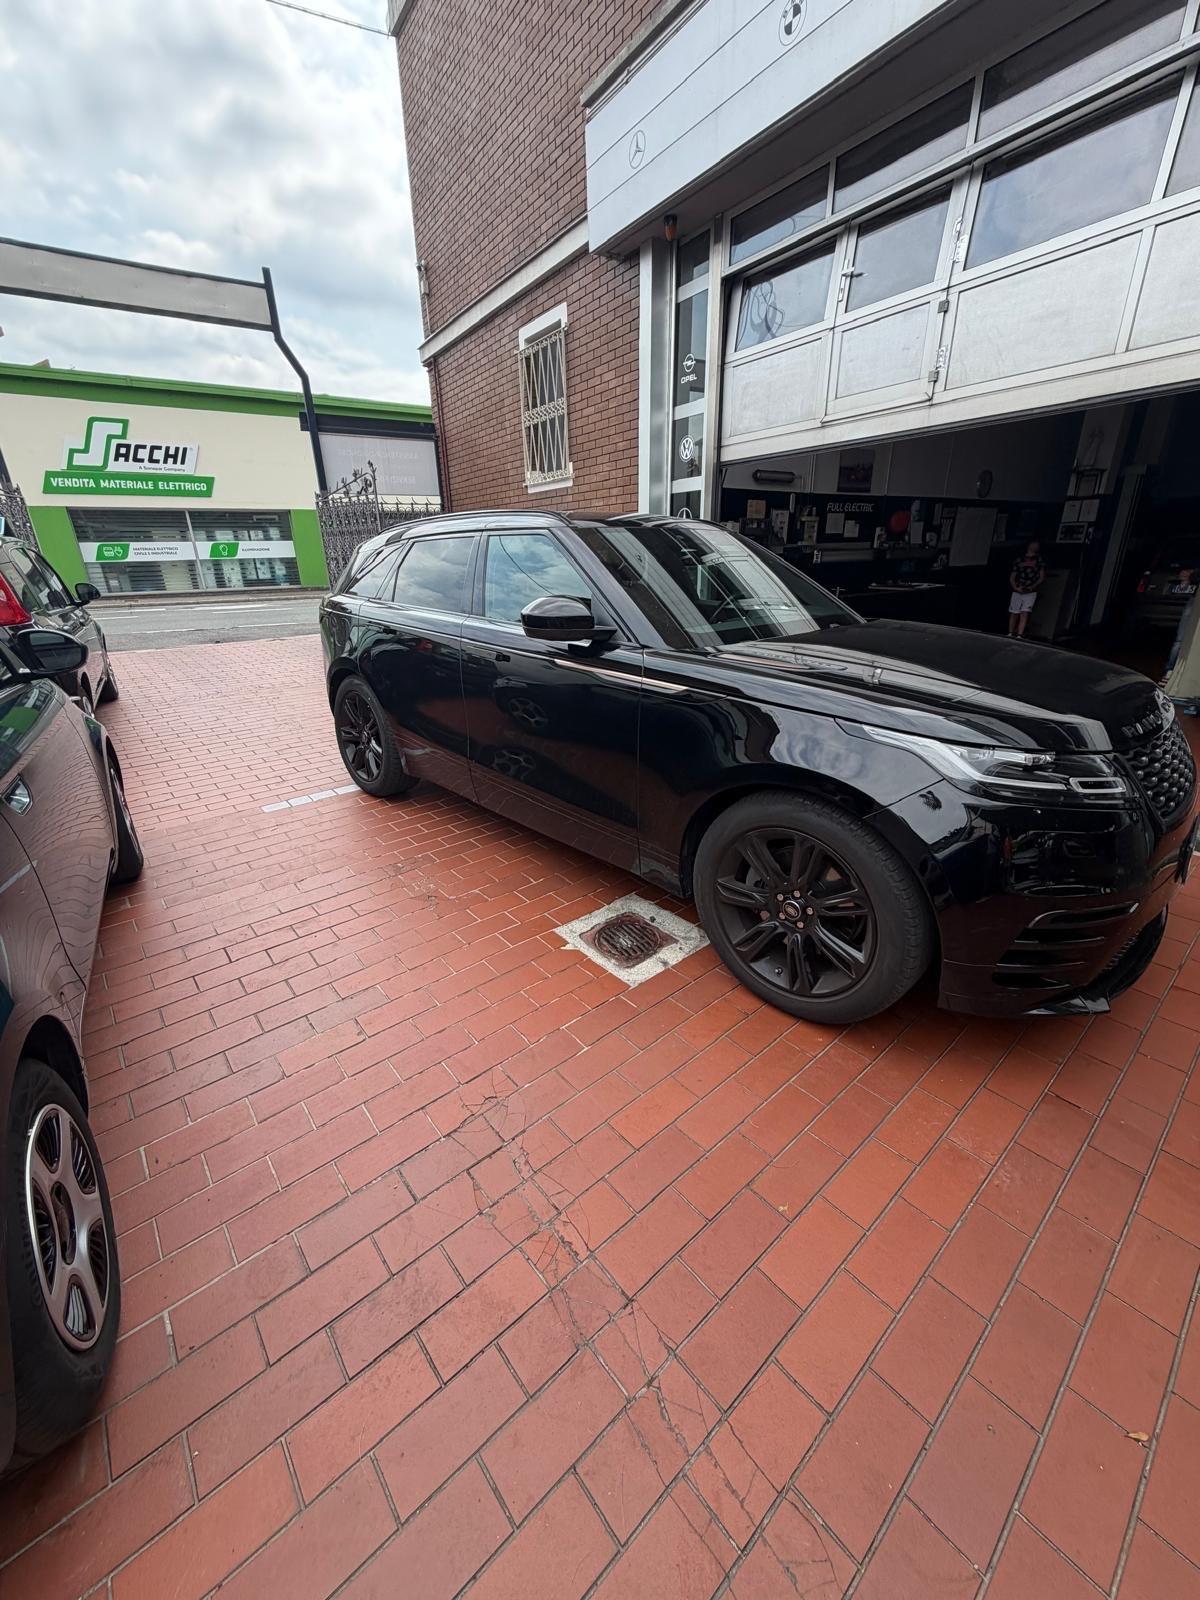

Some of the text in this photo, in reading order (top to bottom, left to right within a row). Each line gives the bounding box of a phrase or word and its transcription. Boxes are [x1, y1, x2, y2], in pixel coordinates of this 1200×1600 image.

[681, 374, 698, 384] OPEL
[50, 477, 207, 491] VENDITA MATERIALE ELETTRICO
[826, 502, 875, 512] FULL ELECTRIC
